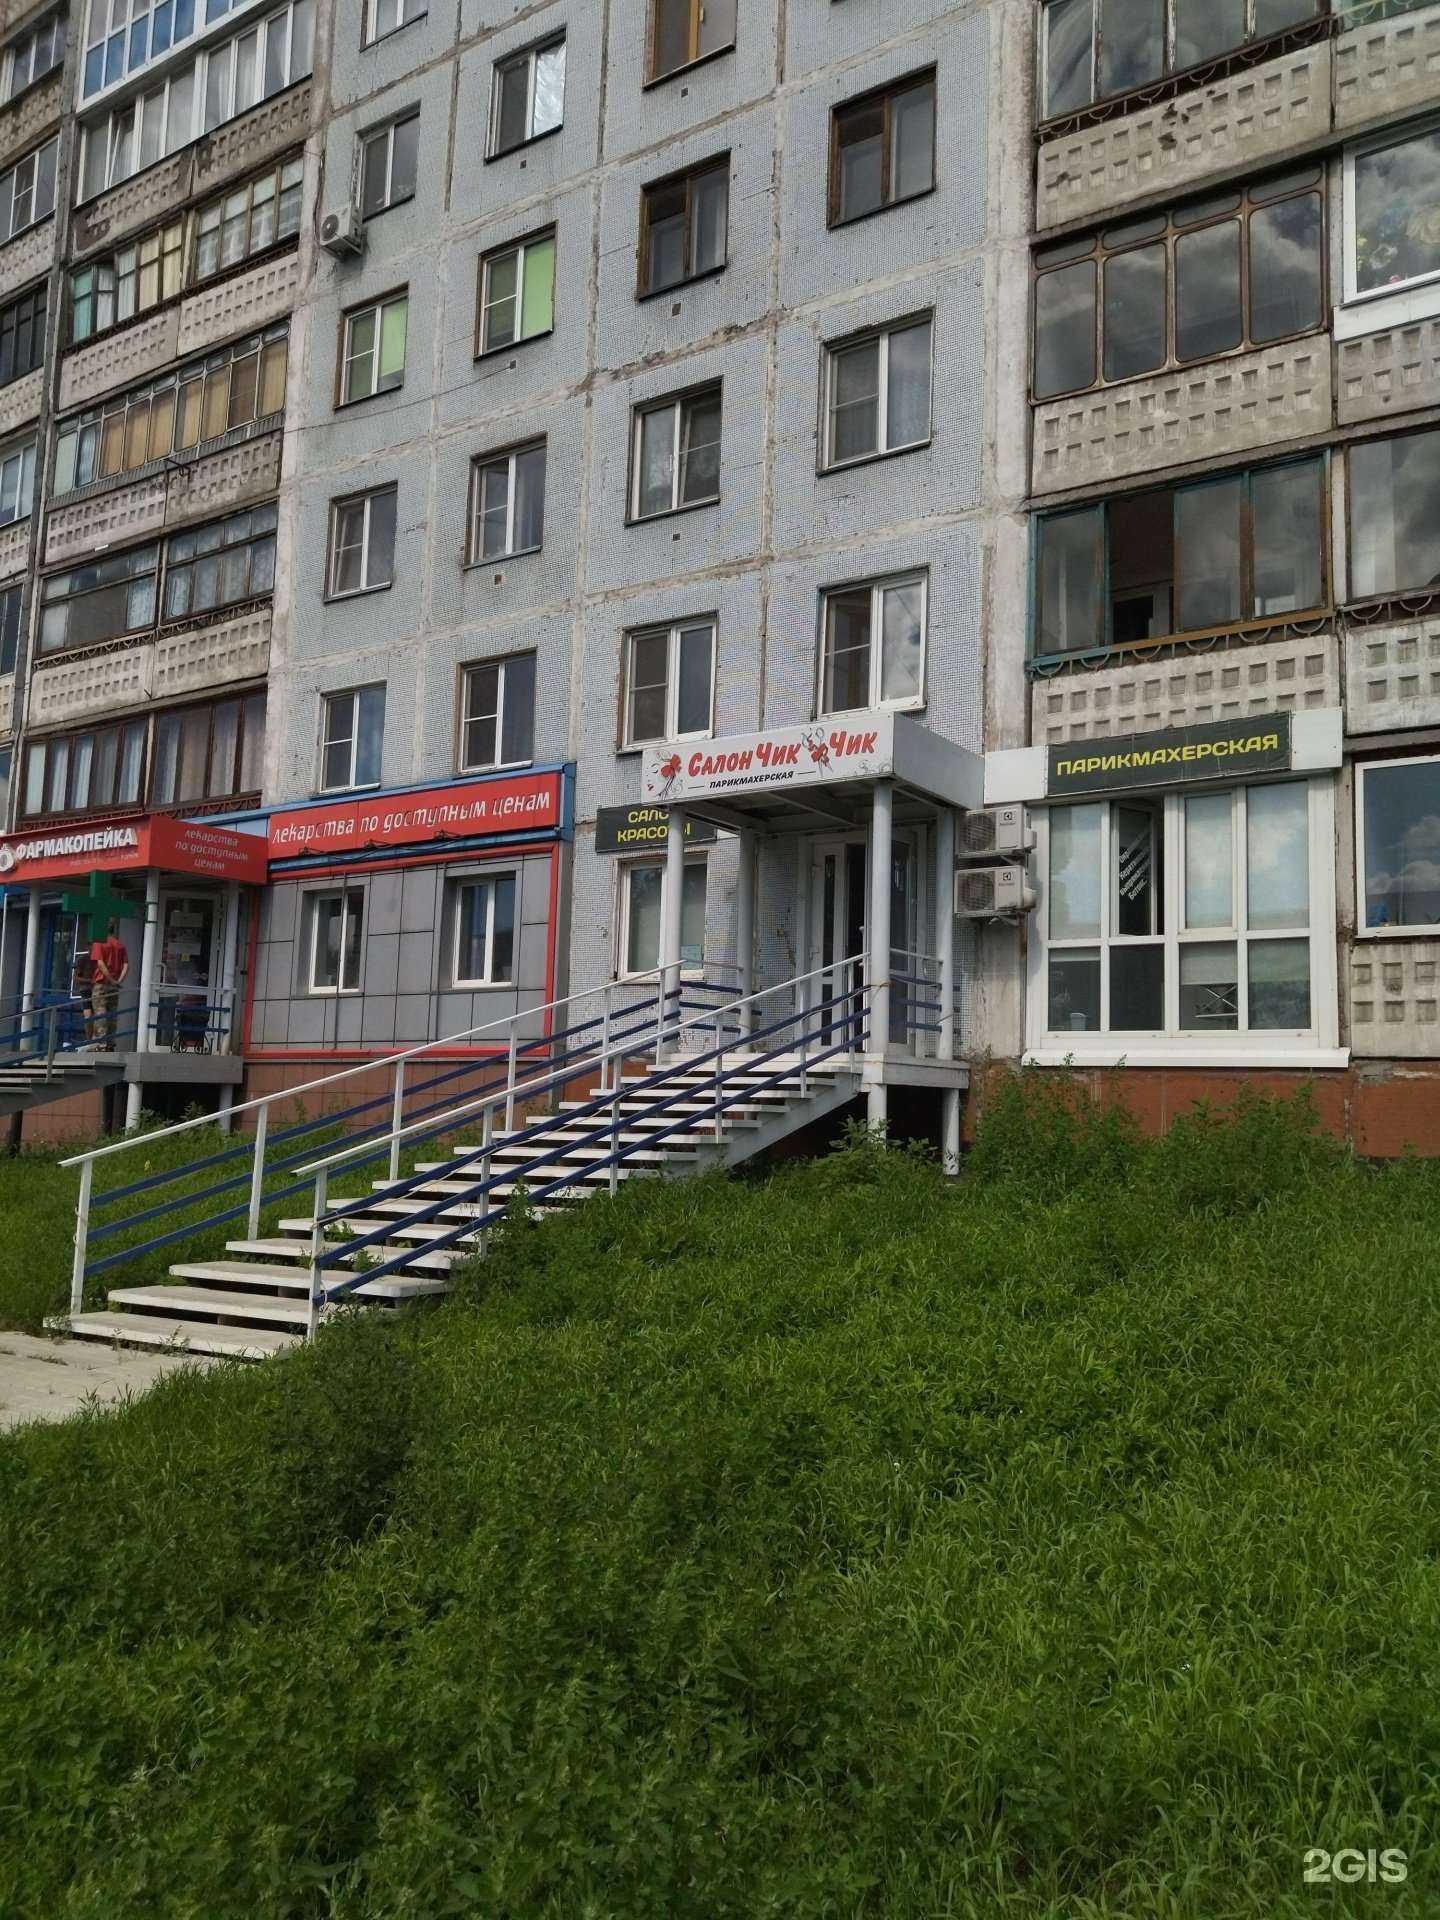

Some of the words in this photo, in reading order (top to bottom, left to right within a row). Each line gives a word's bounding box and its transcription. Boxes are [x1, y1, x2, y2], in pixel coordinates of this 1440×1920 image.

[1057, 734, 1278, 776] ПАРИКМАХЕРСКАЯ
[709, 770, 794, 789] ПАРИКМАХЕРСКАЯ
[272, 818, 354, 844] лекарства
[360, 815, 378, 833] по
[383, 801, 486, 833] доступным
[492, 791, 550, 816] ценам
[15, 826, 138, 860] ФАРМАКОПЕЙКА
[184, 829, 238, 847] лекарства
[175, 840, 188, 850] по
[190, 844, 248, 862] доступным
[194, 858, 225, 872] ценам
